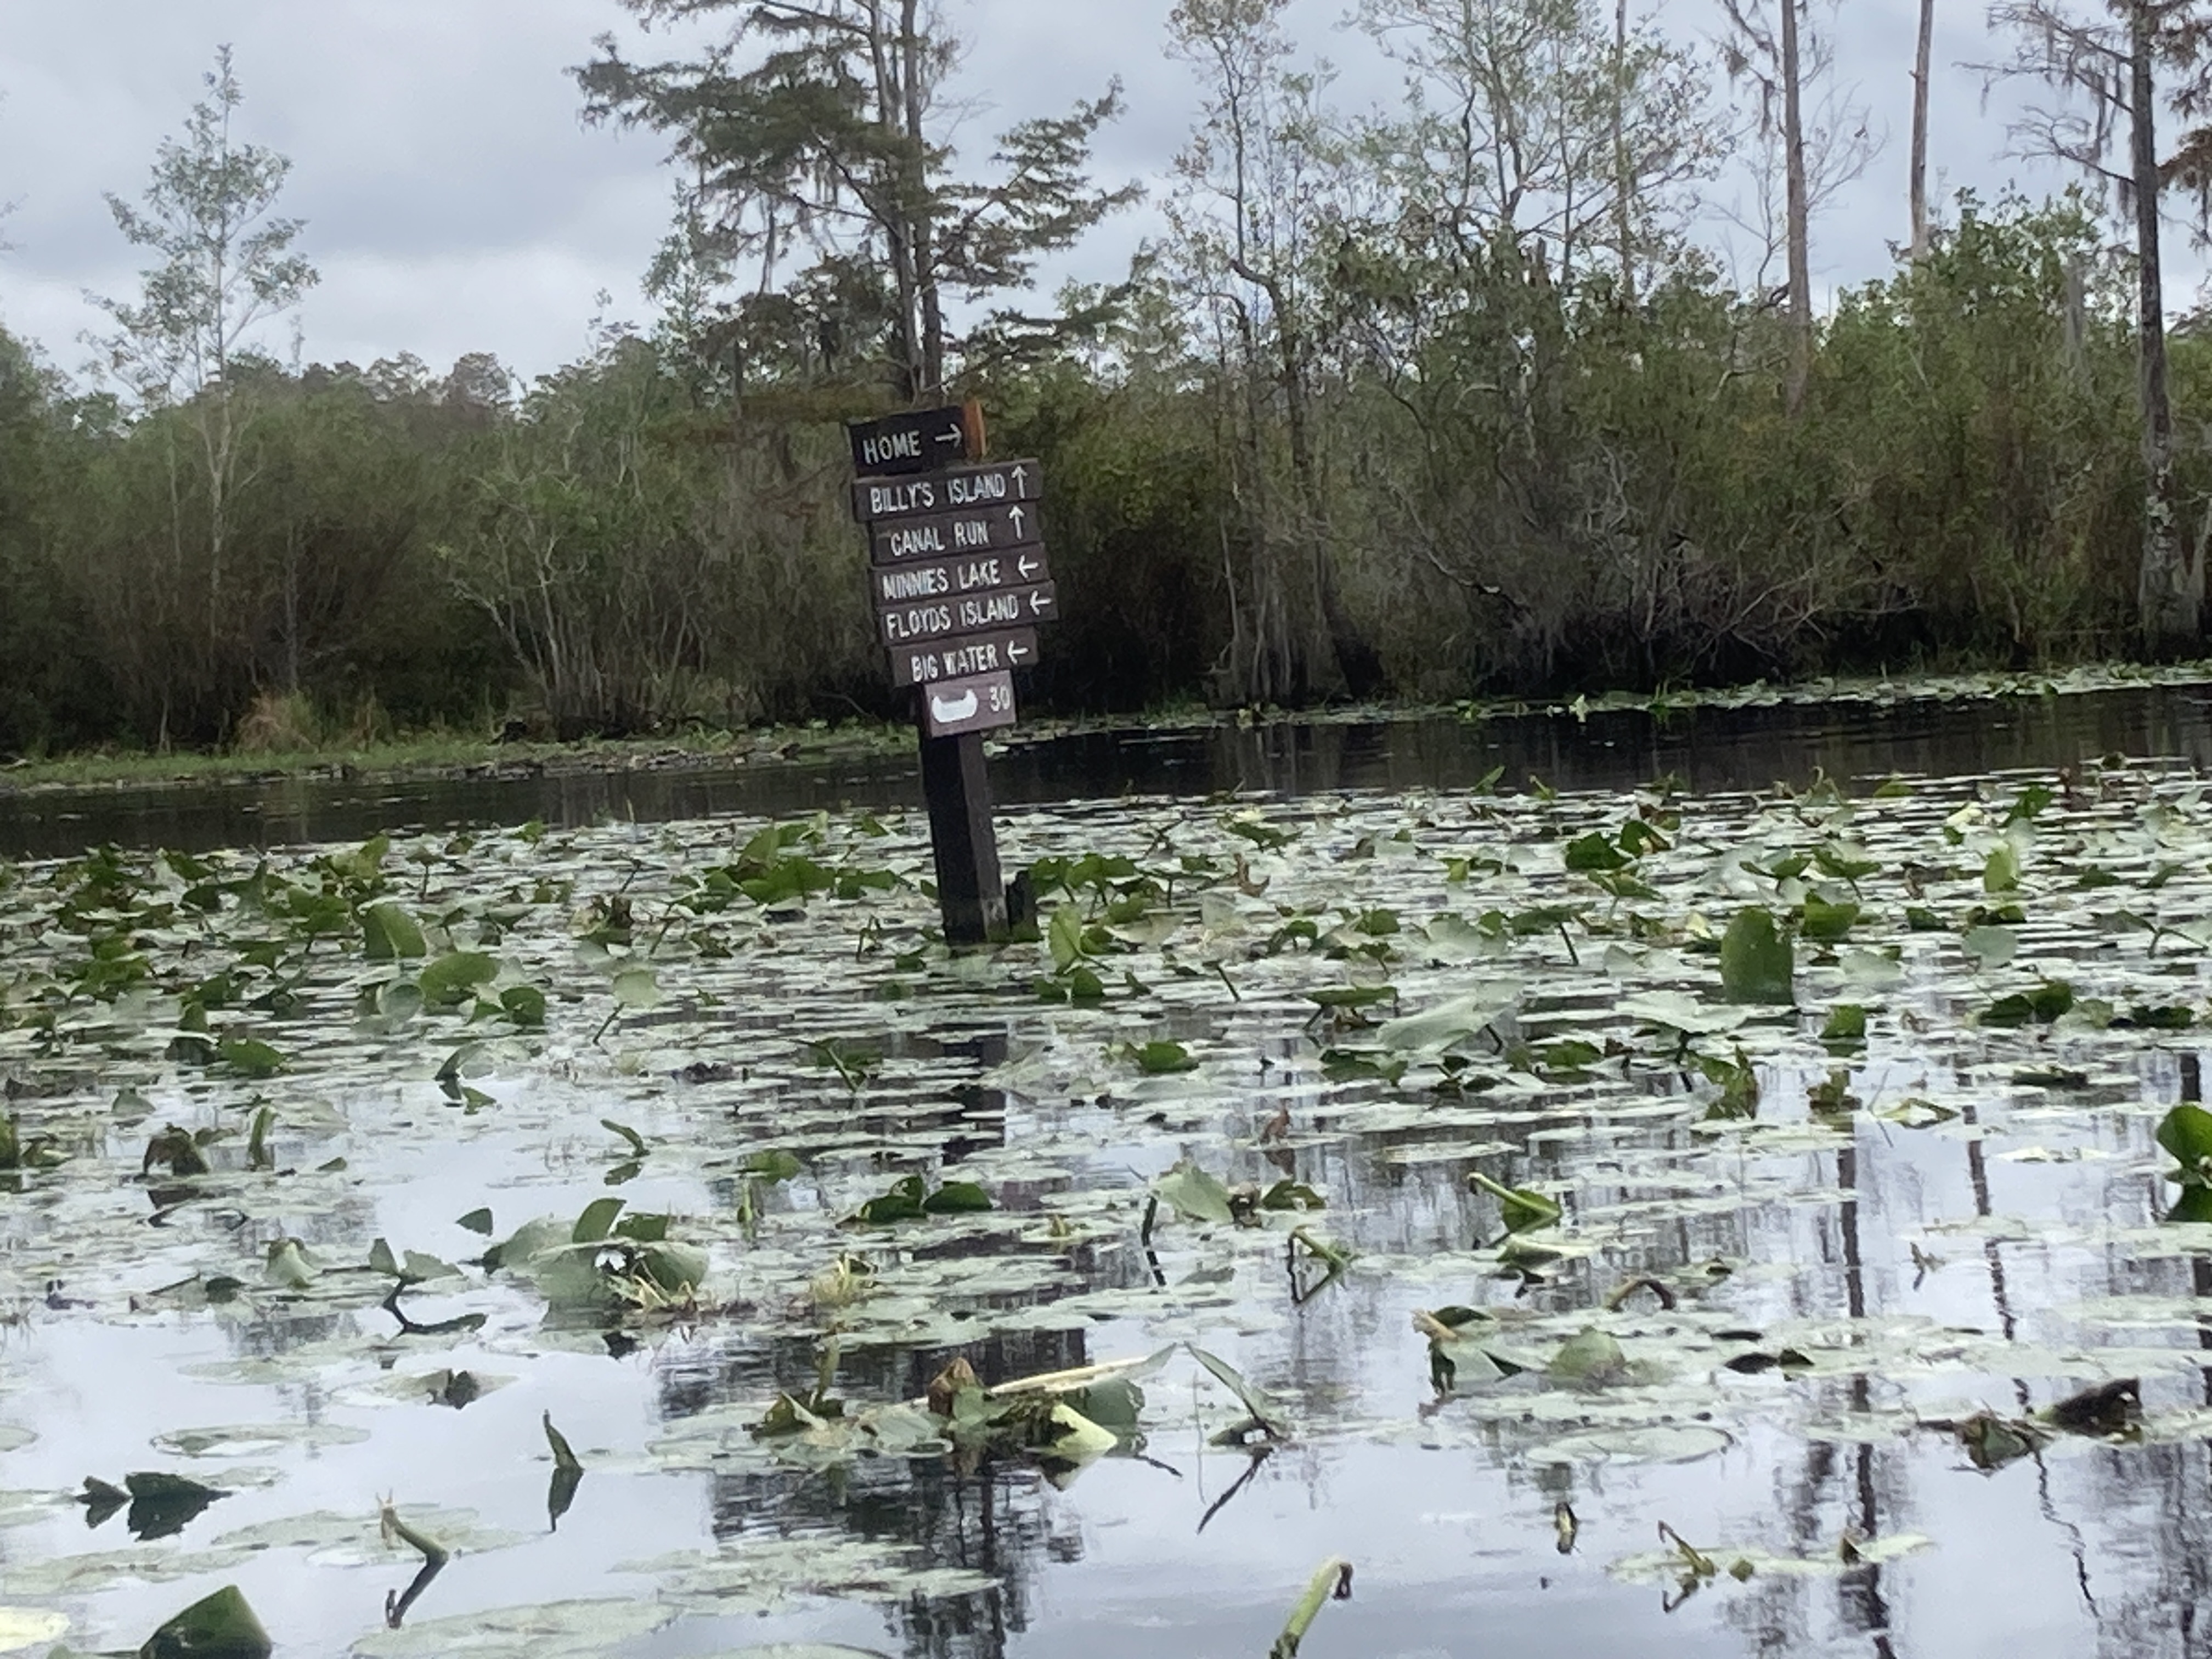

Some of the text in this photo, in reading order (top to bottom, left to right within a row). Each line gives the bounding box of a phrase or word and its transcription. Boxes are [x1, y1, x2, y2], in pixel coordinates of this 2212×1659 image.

[862, 431, 922, 464] HOME
[870, 473, 1006, 514] BILLY'S ISLAND
[890, 521, 990, 556] CANAL RUN
[883, 559, 1001, 600] MINNIES LAKE
[886, 594, 1019, 639] FLOYDS ISLAND
[911, 644, 999, 682] BIG WATER
[989, 686, 1011, 712] 30
